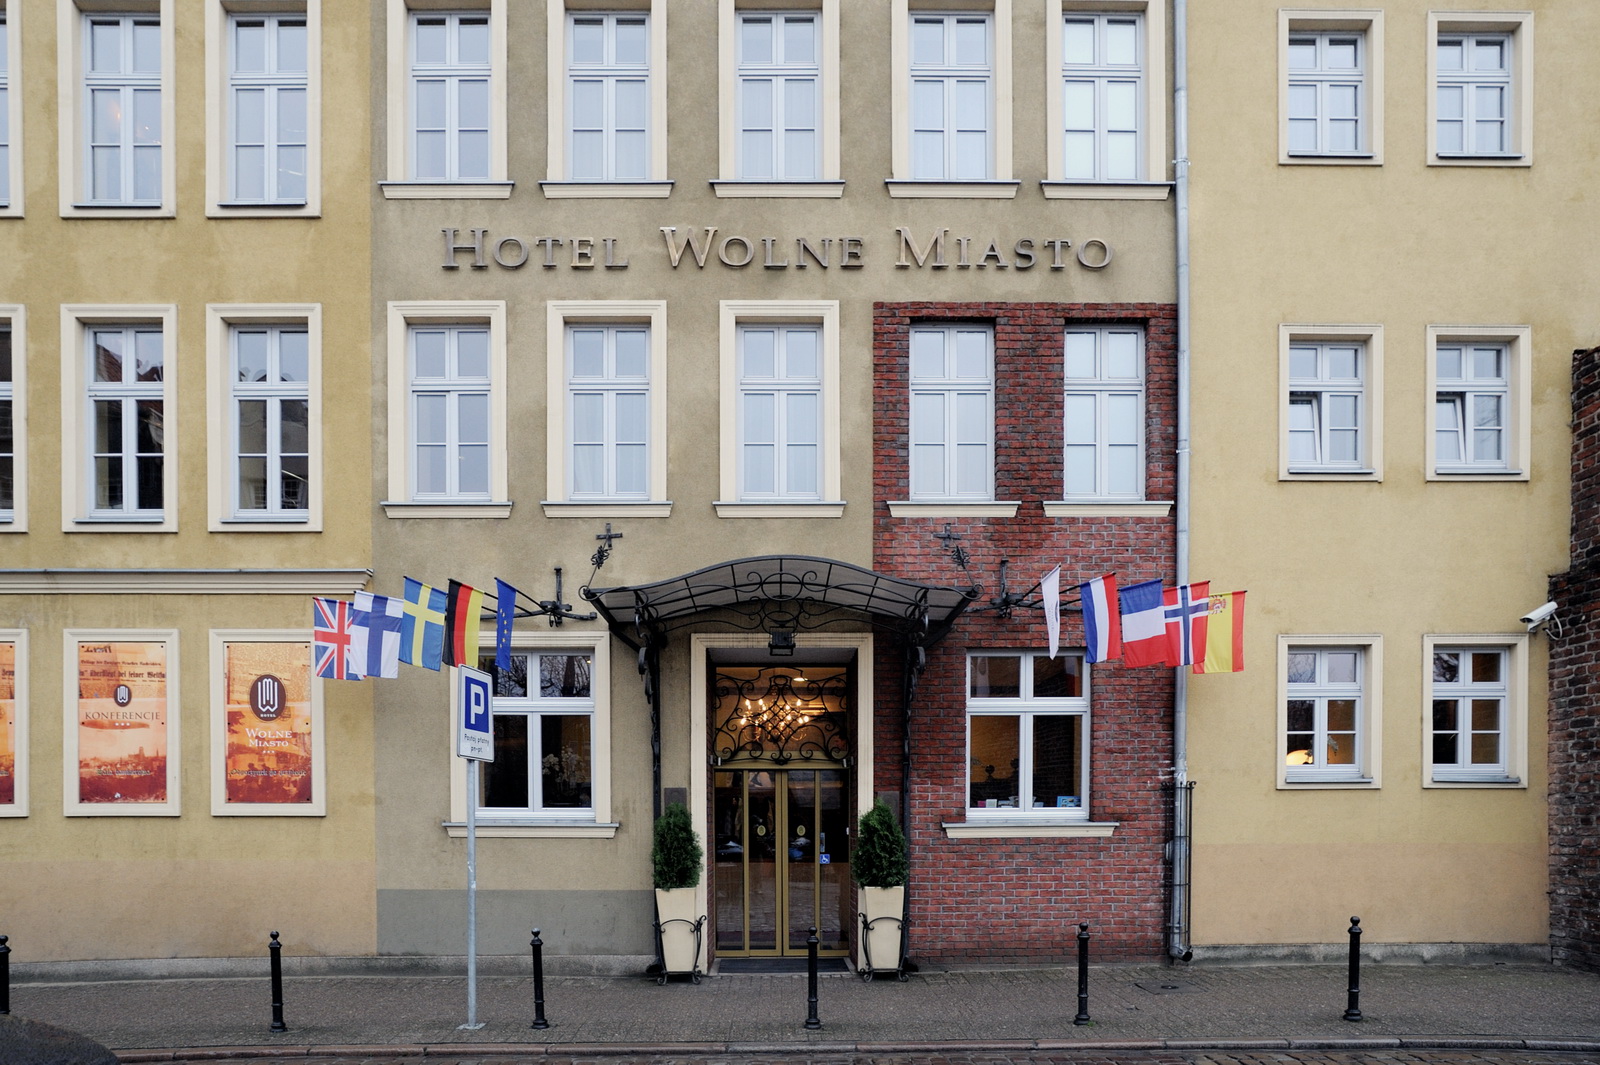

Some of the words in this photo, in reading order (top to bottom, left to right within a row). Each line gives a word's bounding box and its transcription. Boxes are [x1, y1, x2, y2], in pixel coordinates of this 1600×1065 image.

[441, 227, 630, 270] HOTEL
[659, 226, 865, 269] WOLNE
[894, 226, 1114, 270] MIASTO
[470, 683, 485, 725] P
[85, 711, 161, 721] KONFERENCJE
[245, 728, 293, 738] WOLNE
[249, 739, 289, 747] MIASTO
